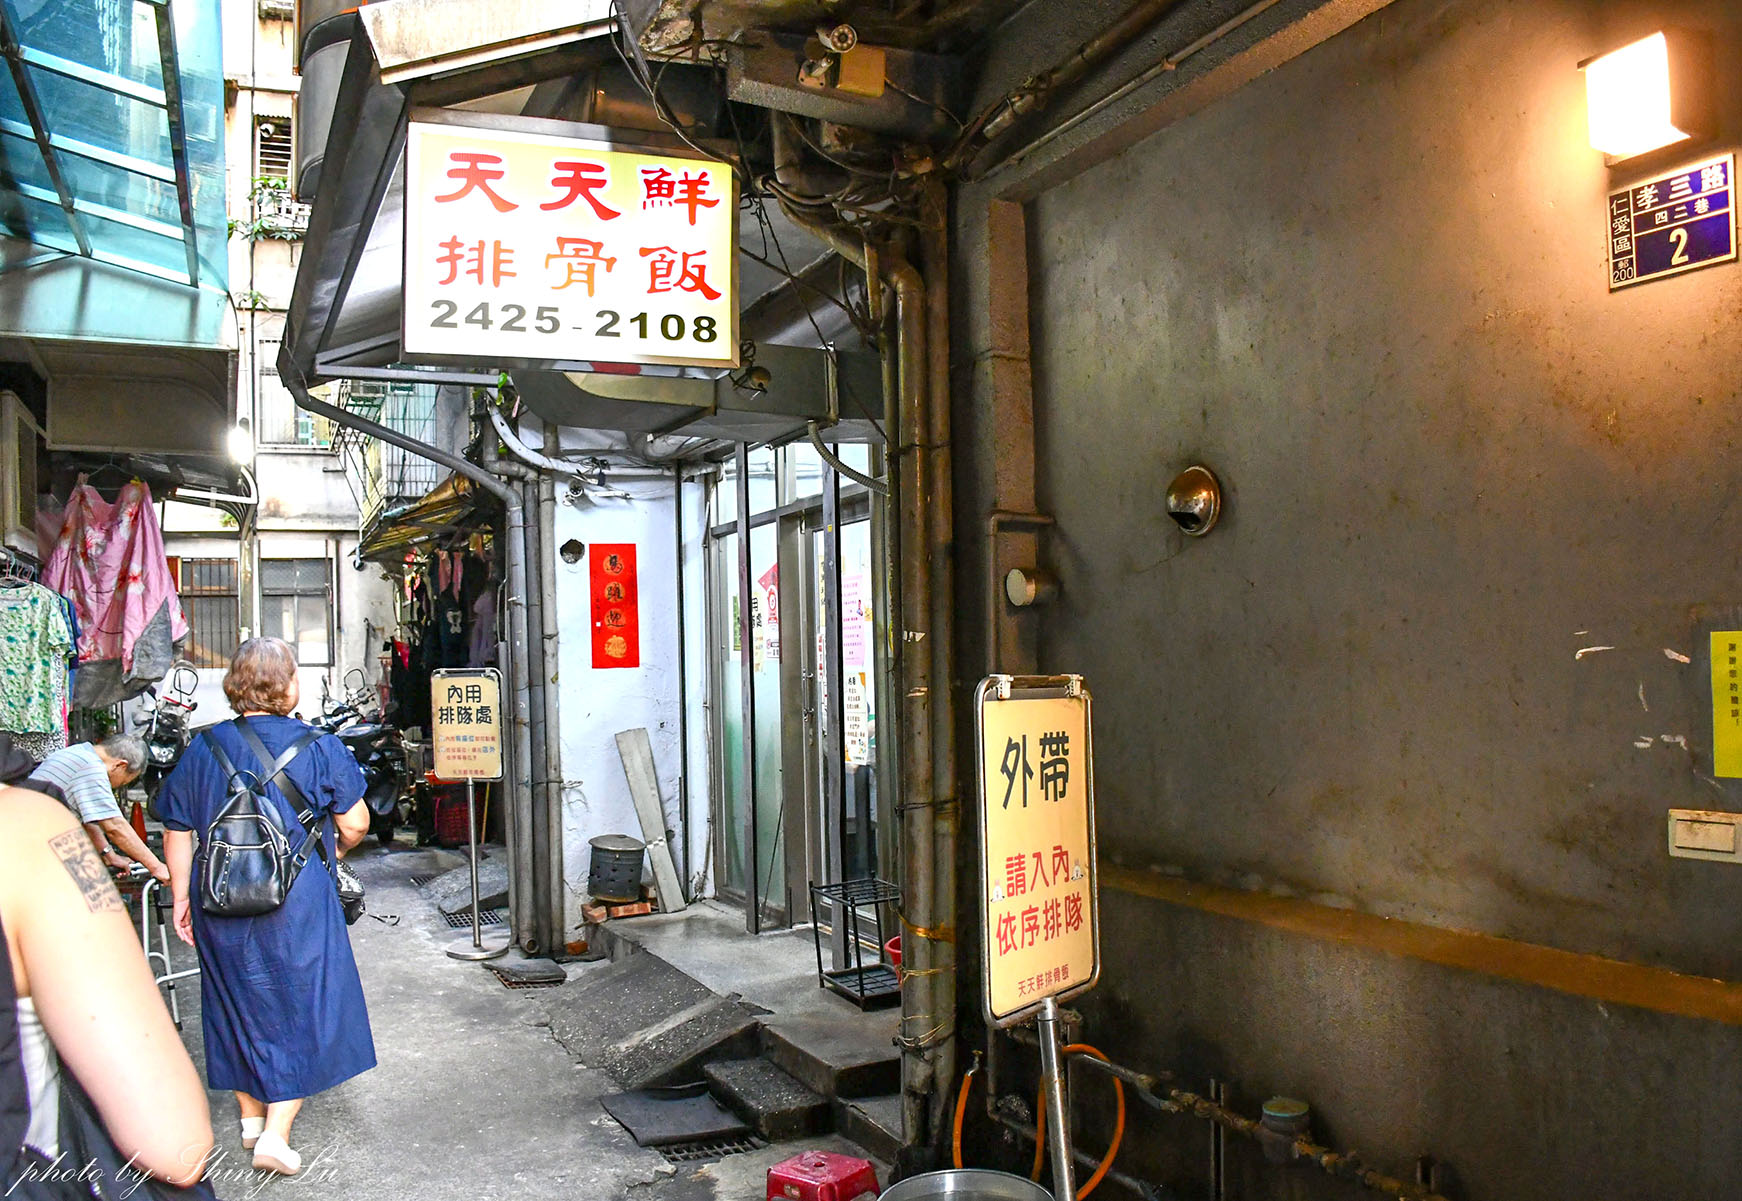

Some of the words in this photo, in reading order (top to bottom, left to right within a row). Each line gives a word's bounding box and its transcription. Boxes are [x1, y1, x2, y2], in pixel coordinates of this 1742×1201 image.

[434, 152, 720, 226] 天天鮮
[1636, 164, 1725, 209] 孝三路
[1611, 198, 1632, 255] 仁愛區
[1669, 227, 1689, 266] 2
[435, 235, 722, 301] 排骨飯
[1612, 266, 1634, 282] 200
[430, 299, 718, 343] 2425-2108
[438, 705, 492, 725] 排隊處
[447, 684, 482, 704] 內用
[1000, 731, 1070, 811] 外帶
[1005, 845, 1070, 898] 請入內
[996, 895, 1083, 957] 依序排隊
